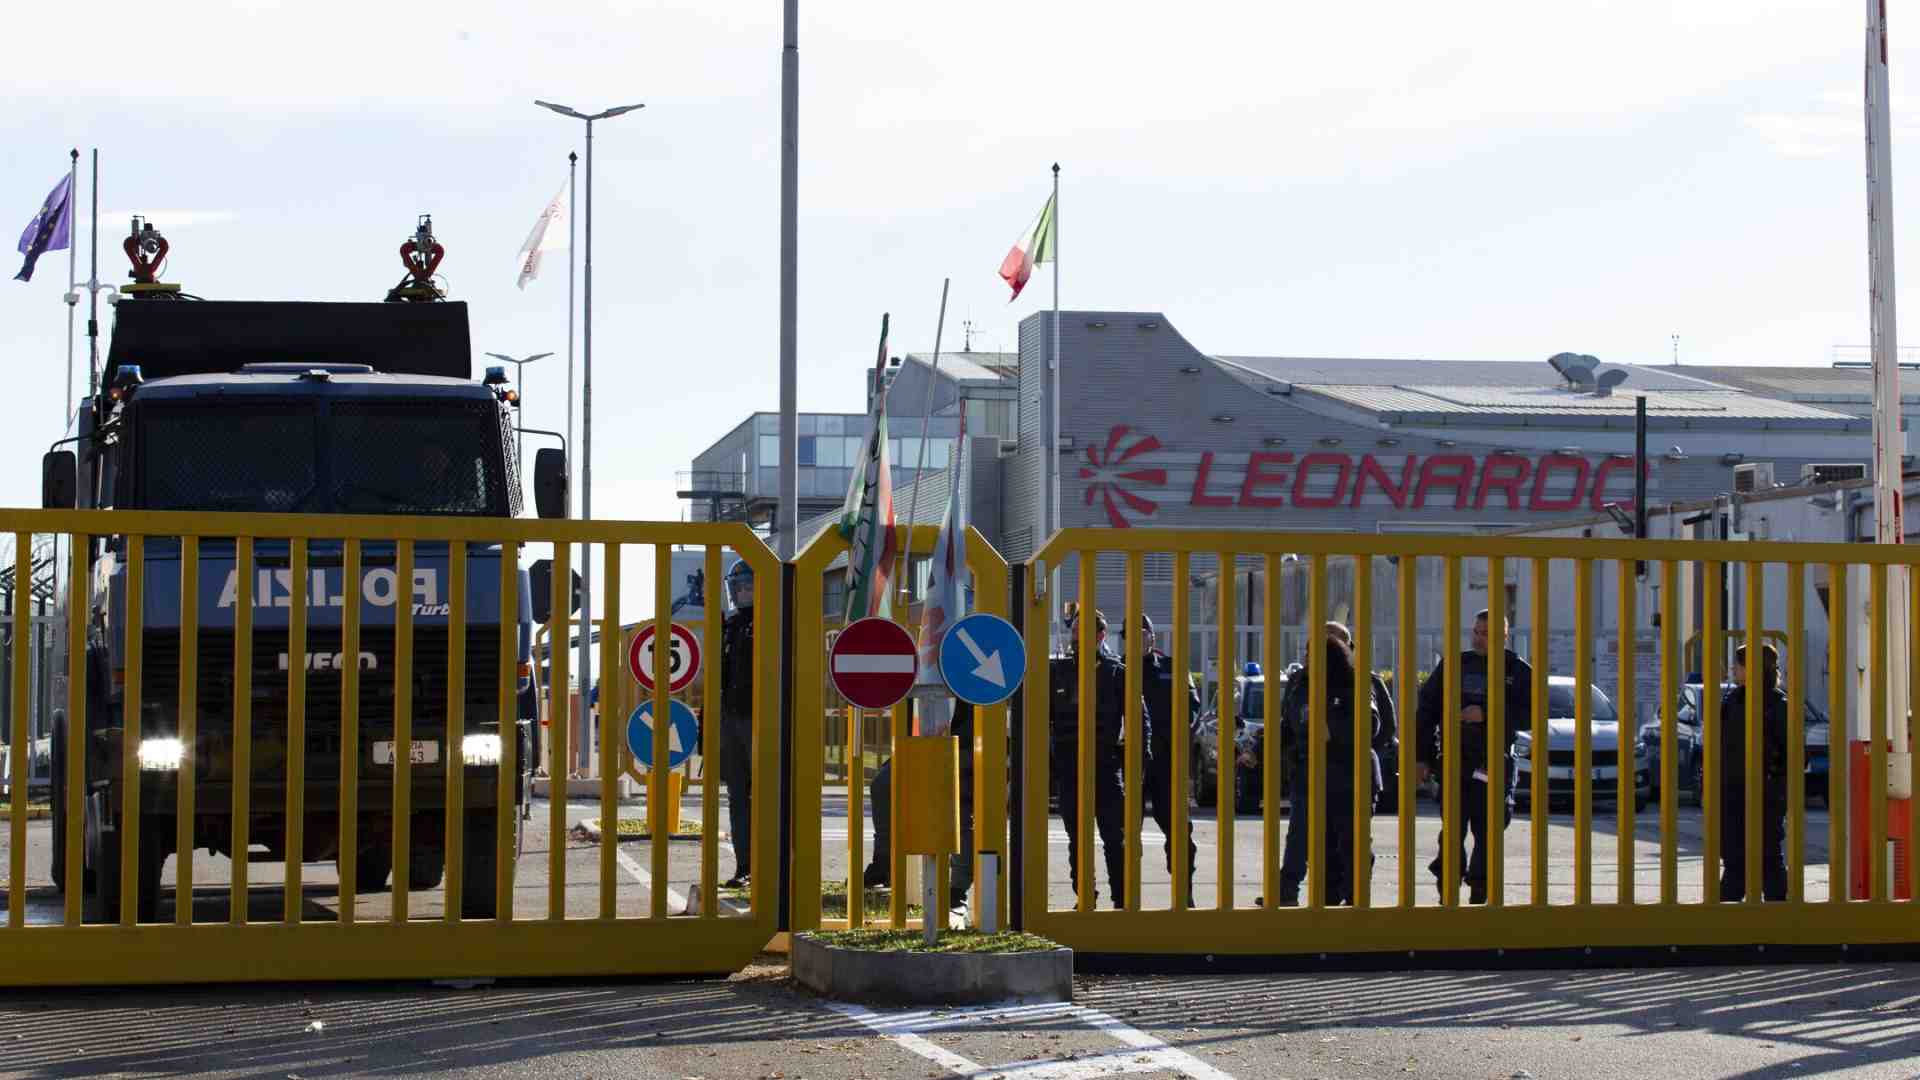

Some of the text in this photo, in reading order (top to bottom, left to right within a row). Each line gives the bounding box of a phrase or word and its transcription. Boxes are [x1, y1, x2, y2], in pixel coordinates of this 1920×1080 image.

[411, 601, 449, 615] Turb
[278, 652, 377, 670] IEO
[648, 640, 681, 674] 15
[387, 751, 424, 763] A43
